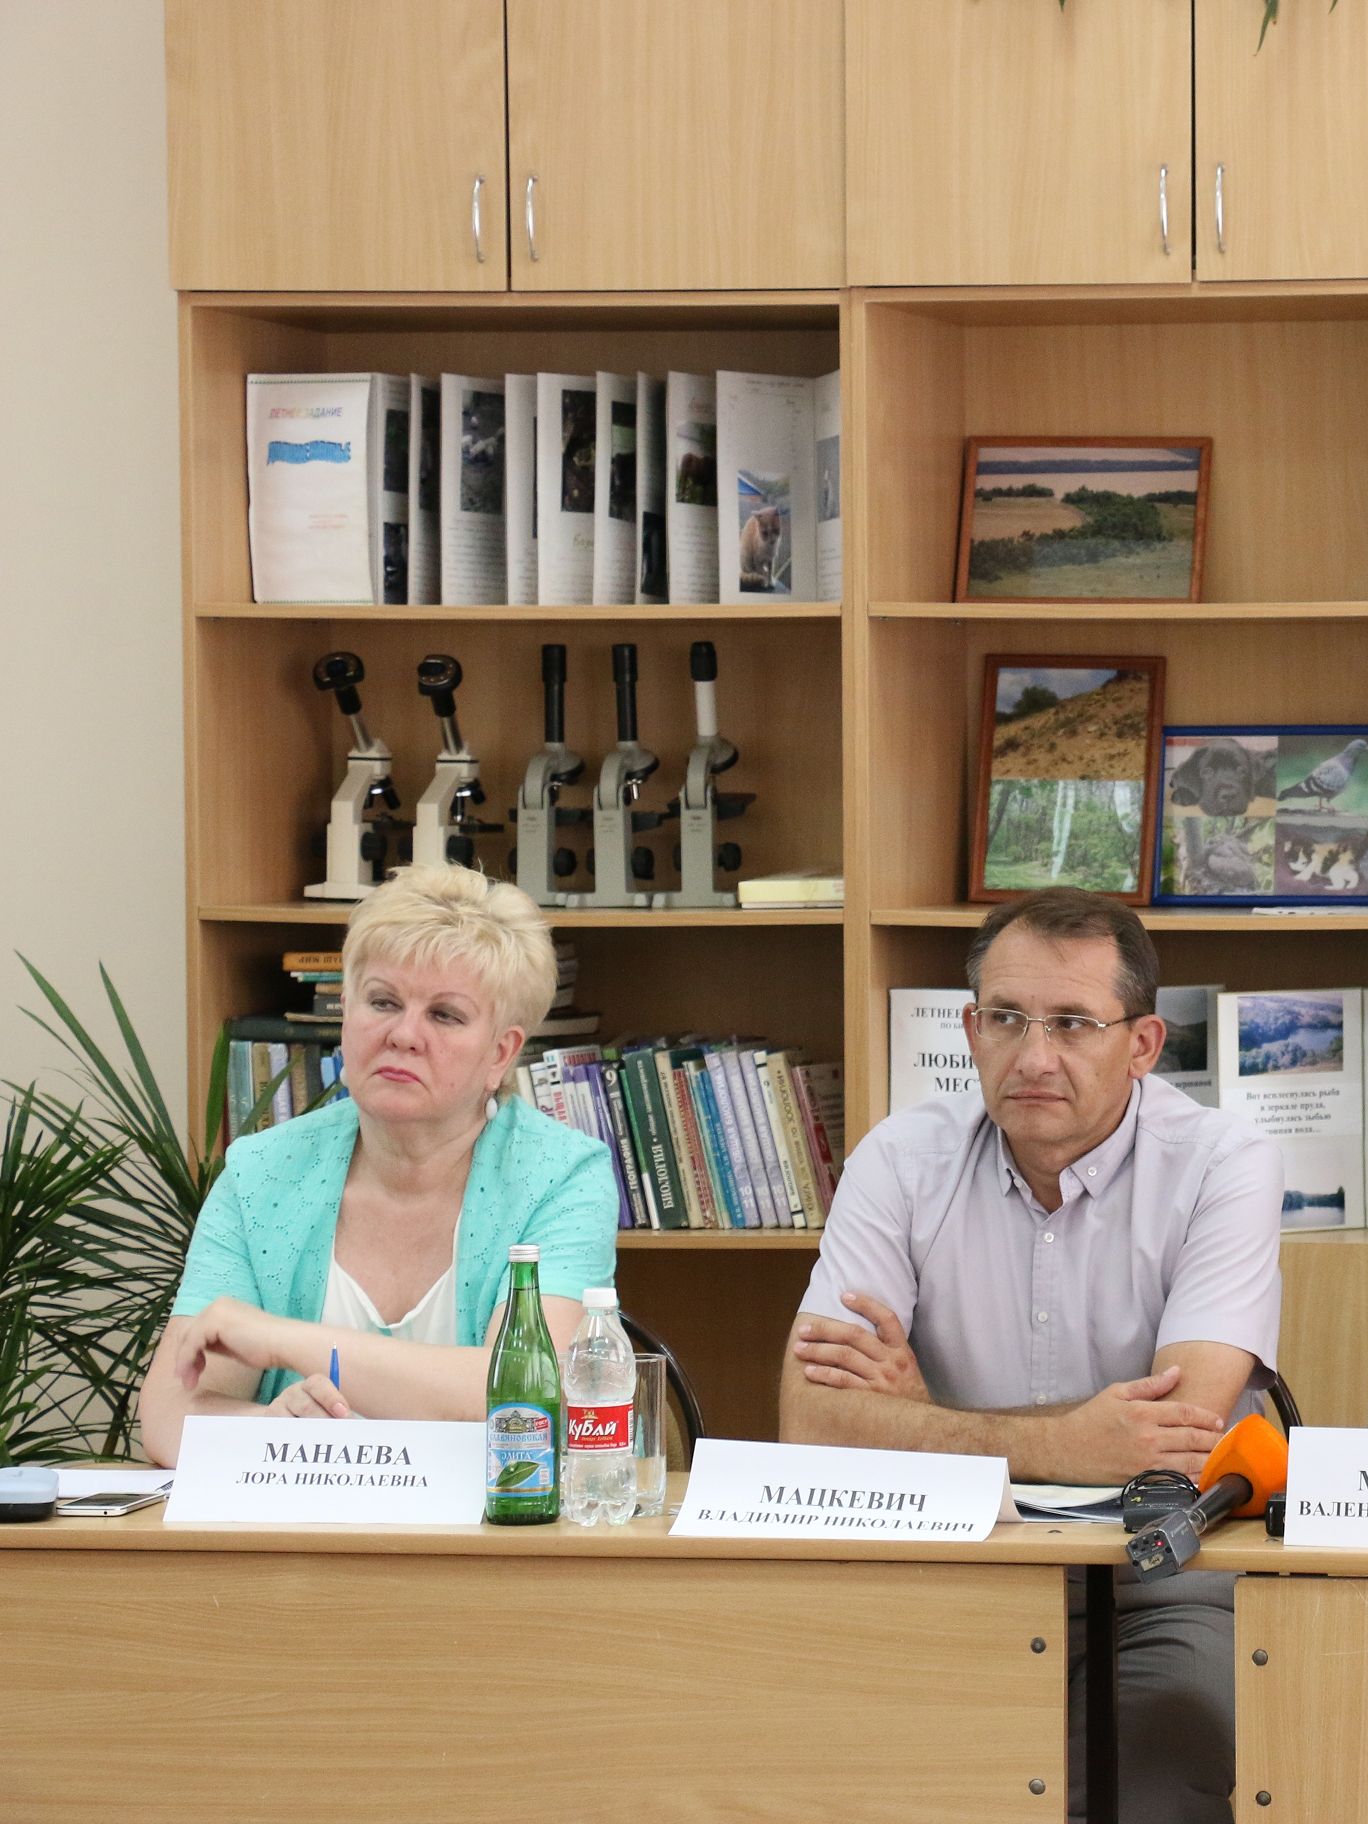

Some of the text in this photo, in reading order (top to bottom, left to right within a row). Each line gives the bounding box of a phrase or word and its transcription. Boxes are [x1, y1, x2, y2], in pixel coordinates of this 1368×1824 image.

[913, 1052, 974, 1069] ЛЮБИ
[605, 1069, 618, 1087] 9
[935, 1076, 980, 1093] МЕС
[726, 1125, 743, 1164] ОБЩАЯ
[619, 1138, 638, 1190] ГЕОГРАФИЯ
[650, 1143, 675, 1210] БИОЛОГИЯ
[264, 1442, 411, 1465] МАНАЕВА
[501, 1450, 531, 1460] ЭЛИТА
[236, 1472, 428, 1488] ЛОРА НИКОЛАЕВНА
[760, 1485, 927, 1512] МАЦКЕВИЧ
[698, 1509, 974, 1533] ВЛАДИМИР НИКОЛАЕВИЧ
